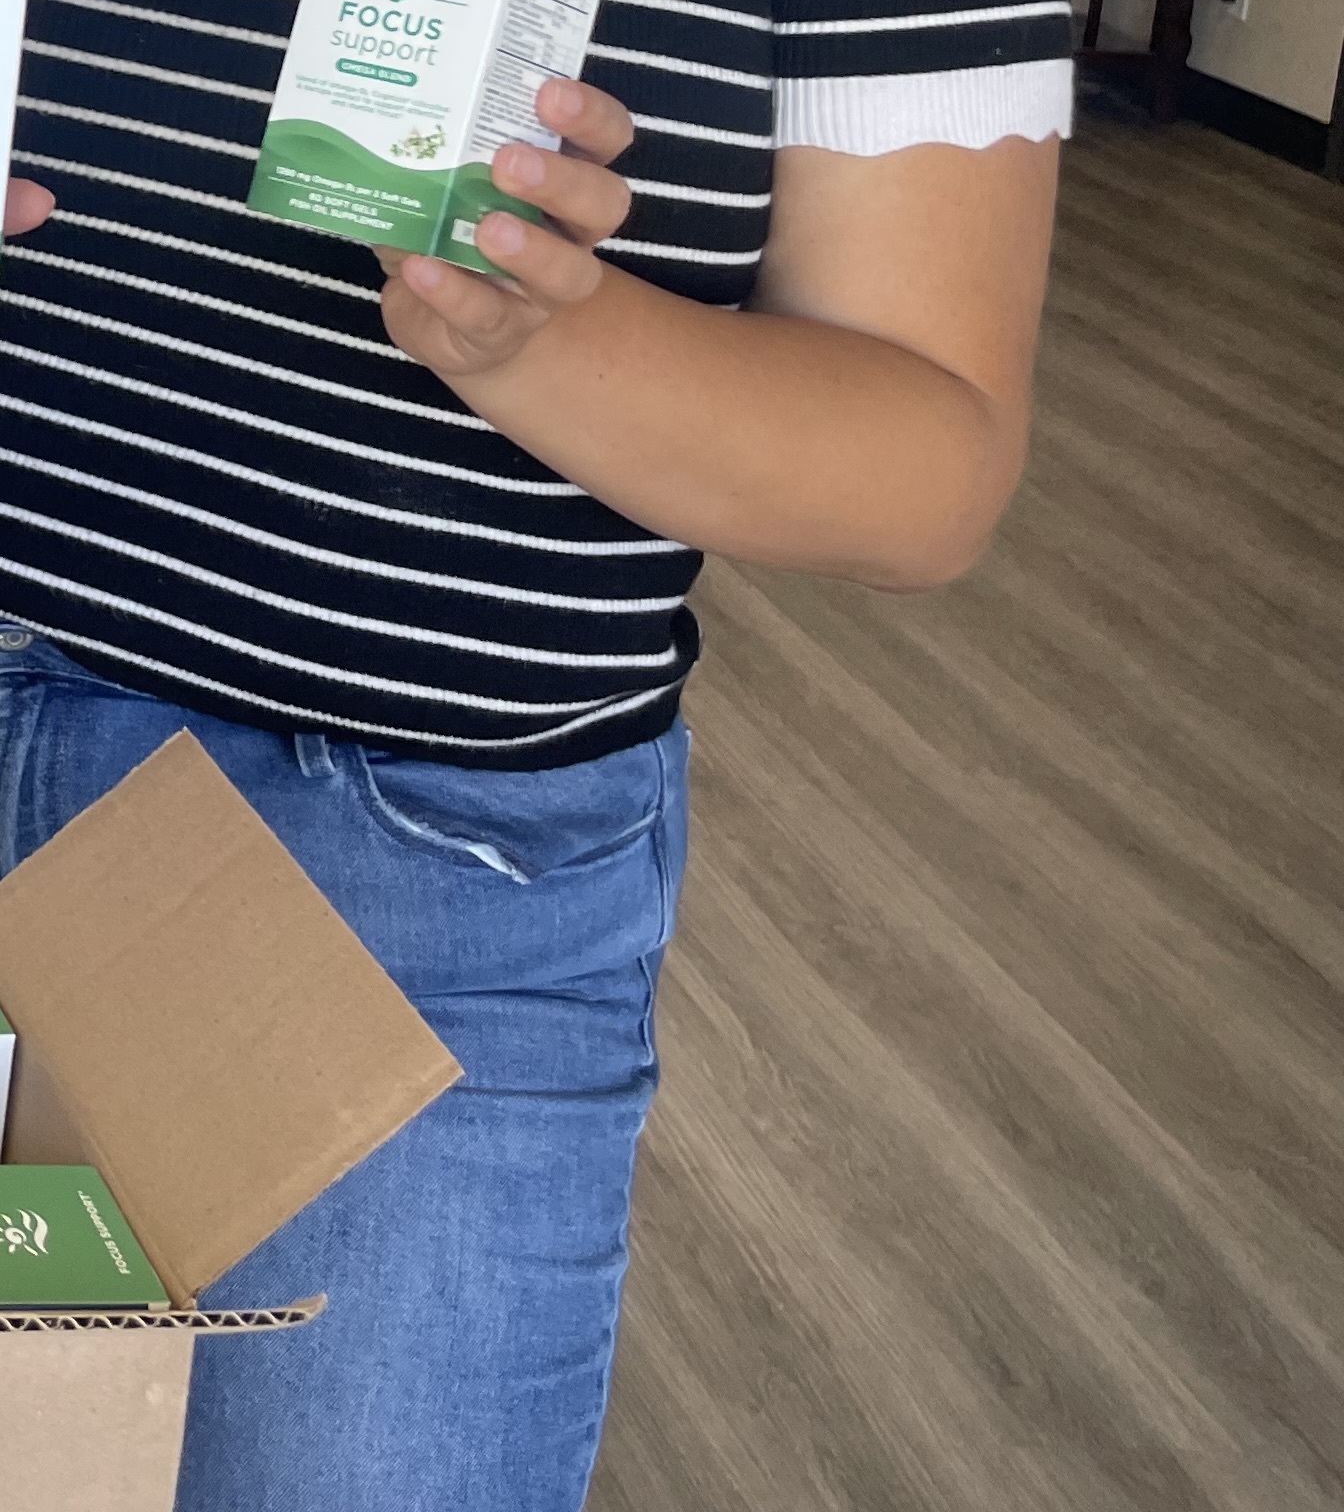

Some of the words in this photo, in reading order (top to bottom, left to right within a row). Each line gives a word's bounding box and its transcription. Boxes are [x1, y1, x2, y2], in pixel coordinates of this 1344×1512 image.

[338, 1, 445, 40] FOCUS
[330, 29, 439, 66] support
[78, 1191, 112, 1239] SUPPORT
[104, 1240, 131, 1275] FOCUS
